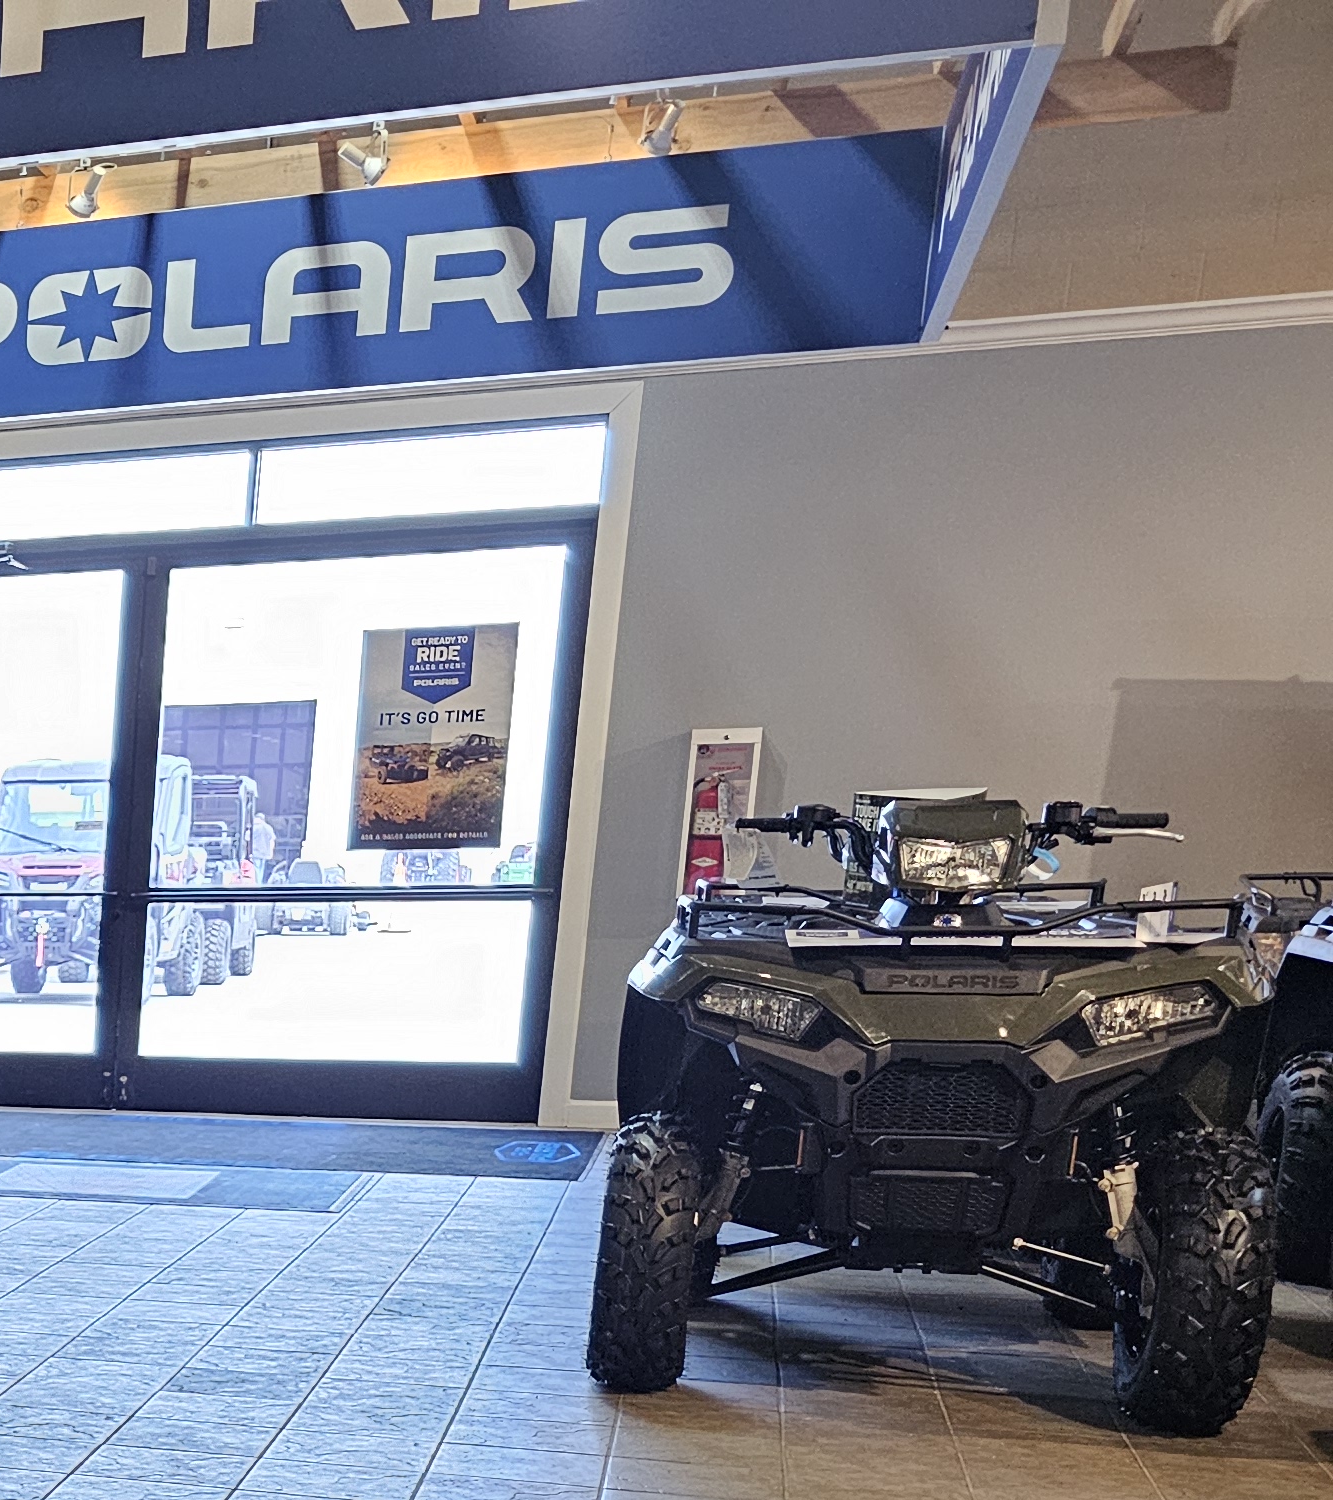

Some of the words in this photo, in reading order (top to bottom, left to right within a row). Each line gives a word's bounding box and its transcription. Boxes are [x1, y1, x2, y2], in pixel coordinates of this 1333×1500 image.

[416, 645, 461, 663] RIDE
[416, 711, 439, 724] GO
[447, 709, 486, 723] TIME
[887, 973, 1021, 990] POLARIS
